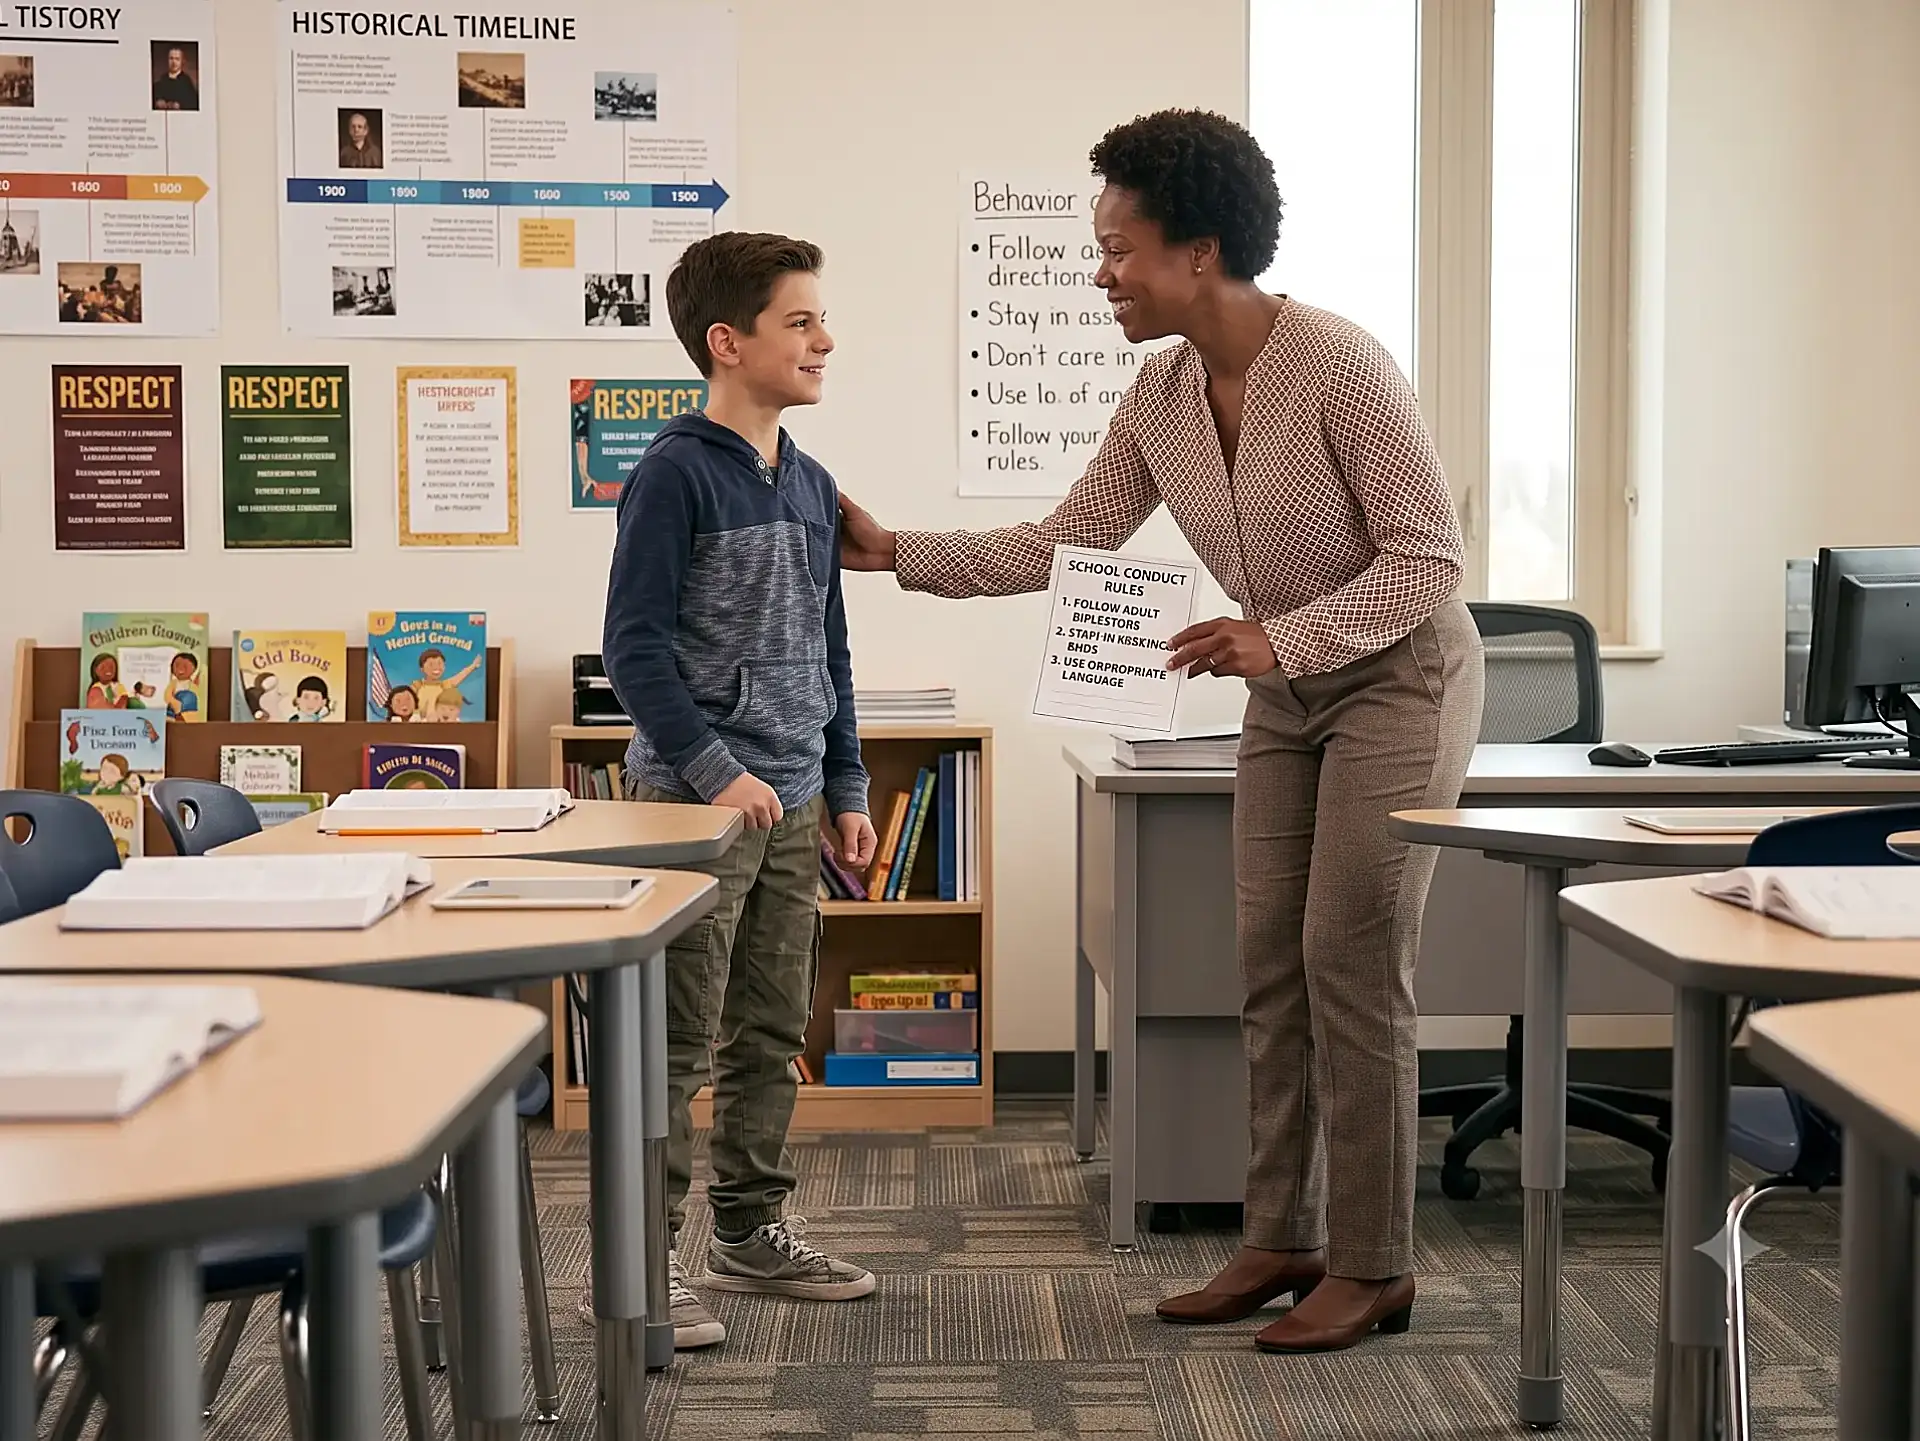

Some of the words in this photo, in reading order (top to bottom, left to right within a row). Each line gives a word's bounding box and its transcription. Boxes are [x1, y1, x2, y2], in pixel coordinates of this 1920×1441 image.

[15, 6, 121, 29] TISTORY
[293, 12, 447, 37] HISTORICAL
[454, 15, 576, 39] TIMELINE
[318, 186, 345, 196] 1900
[671, 191, 699, 202] 1500
[974, 181, 1078, 212] Behavior
[989, 234, 1065, 260] Follow
[989, 301, 1039, 333] Stay
[1050, 306, 1068, 325] in
[988, 342, 1046, 366] Don't
[1058, 351, 1105, 366] care
[1116, 347, 1135, 366] in
[60, 376, 175, 409] RESPECT
[229, 376, 342, 409] RESPECT
[594, 388, 702, 420] RESPECT
[988, 382, 1027, 404] Use
[1069, 382, 1091, 403] of
[987, 421, 1050, 444] Follow
[1060, 431, 1101, 453] your
[988, 449, 1044, 470] rules.
[1068, 560, 1120, 577] SCHOOL
[1123, 567, 1187, 586] CONDUCT
[1104, 581, 1144, 597] RULES
[1062, 597, 1071, 607] 1.
[1073, 599, 1120, 614] FOLLOW
[1122, 605, 1160, 619] ADULT
[1056, 626, 1066, 637] 2.
[1072, 612, 1140, 630] BIPLESTORS
[89, 626, 148, 648] Children
[1050, 655, 1061, 666] 3.
[1063, 657, 1085, 669] USE
[1087, 660, 1167, 680] ORPROPRIATE
[1061, 670, 1125, 688] LANGUAGE
